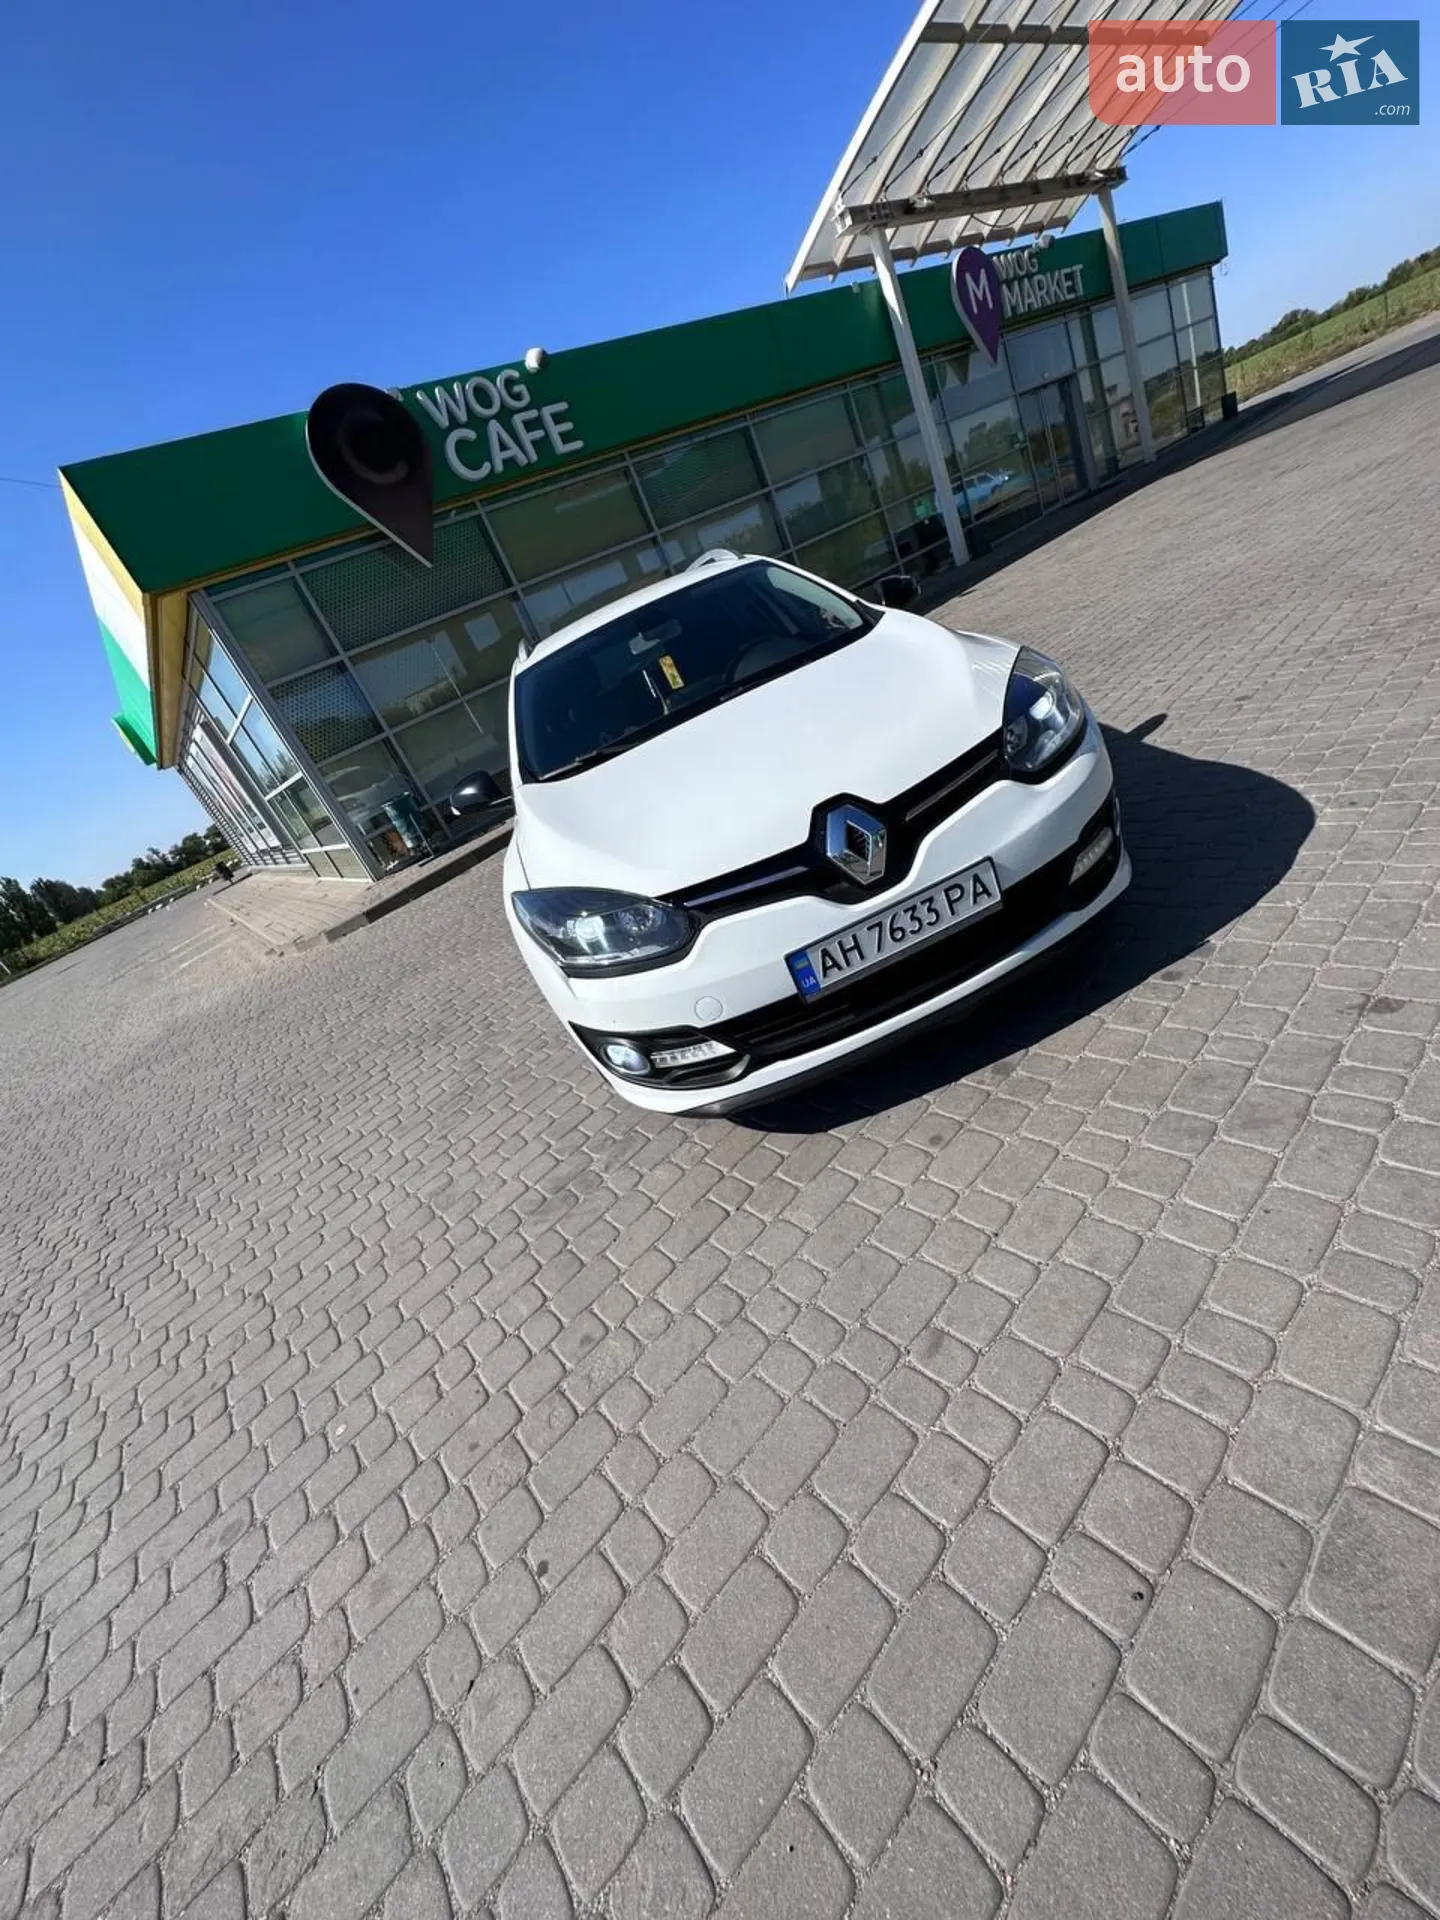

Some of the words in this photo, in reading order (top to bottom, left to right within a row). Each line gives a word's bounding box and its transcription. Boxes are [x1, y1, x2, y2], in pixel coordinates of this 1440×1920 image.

[965, 267, 994, 316] M
[993, 249, 1039, 281] WOG
[1001, 263, 1085, 318] MARKET
[416, 368, 531, 430] WOG
[444, 401, 585, 482] CAFE
[817, 933, 866, 980] AH
[866, 895, 941, 953] 7633
[942, 872, 992, 917] PA
[801, 976, 817, 989] UA
